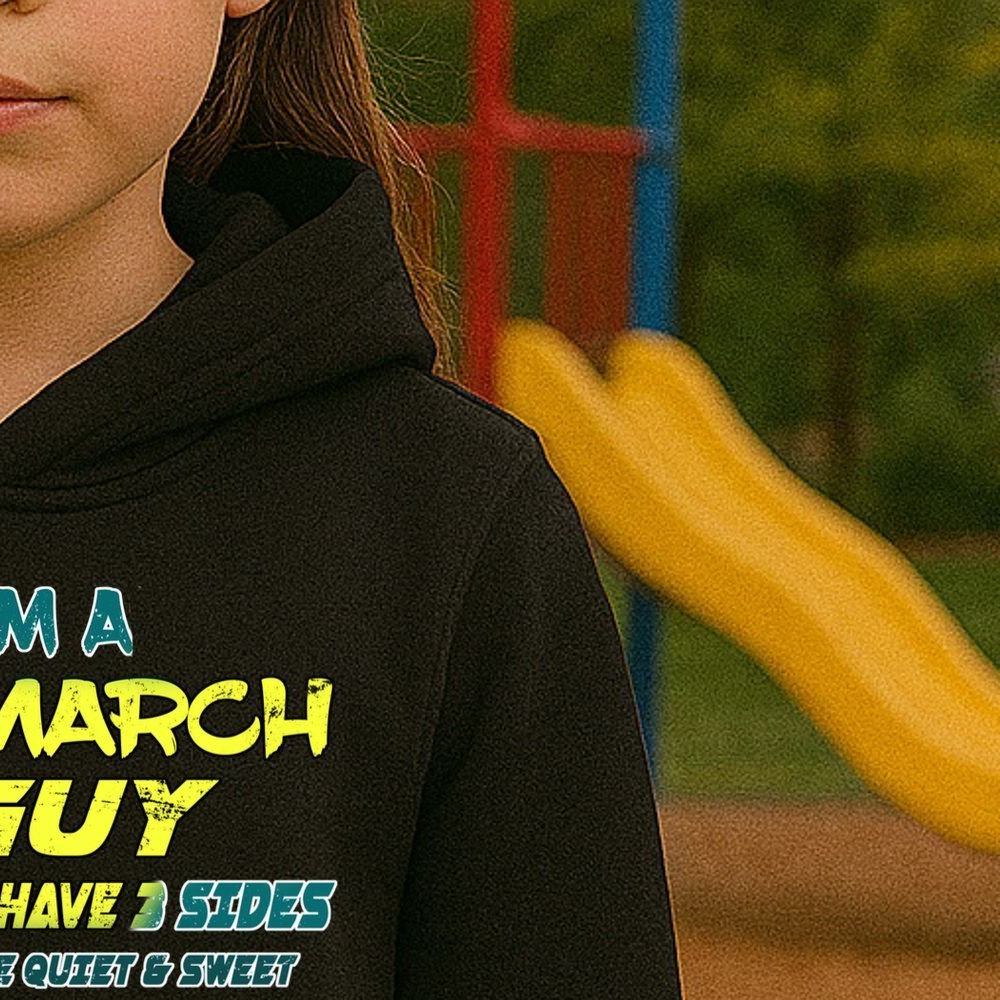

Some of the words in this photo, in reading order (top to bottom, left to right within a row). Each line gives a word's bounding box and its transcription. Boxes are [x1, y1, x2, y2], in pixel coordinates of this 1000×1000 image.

[81, 587, 133, 657] A
[130, 881, 167, 931] 3
[175, 880, 337, 931] SIDES
[22, 952, 138, 989] QUIET
[141, 952, 173, 988] &
[177, 952, 300, 988] SWEET
